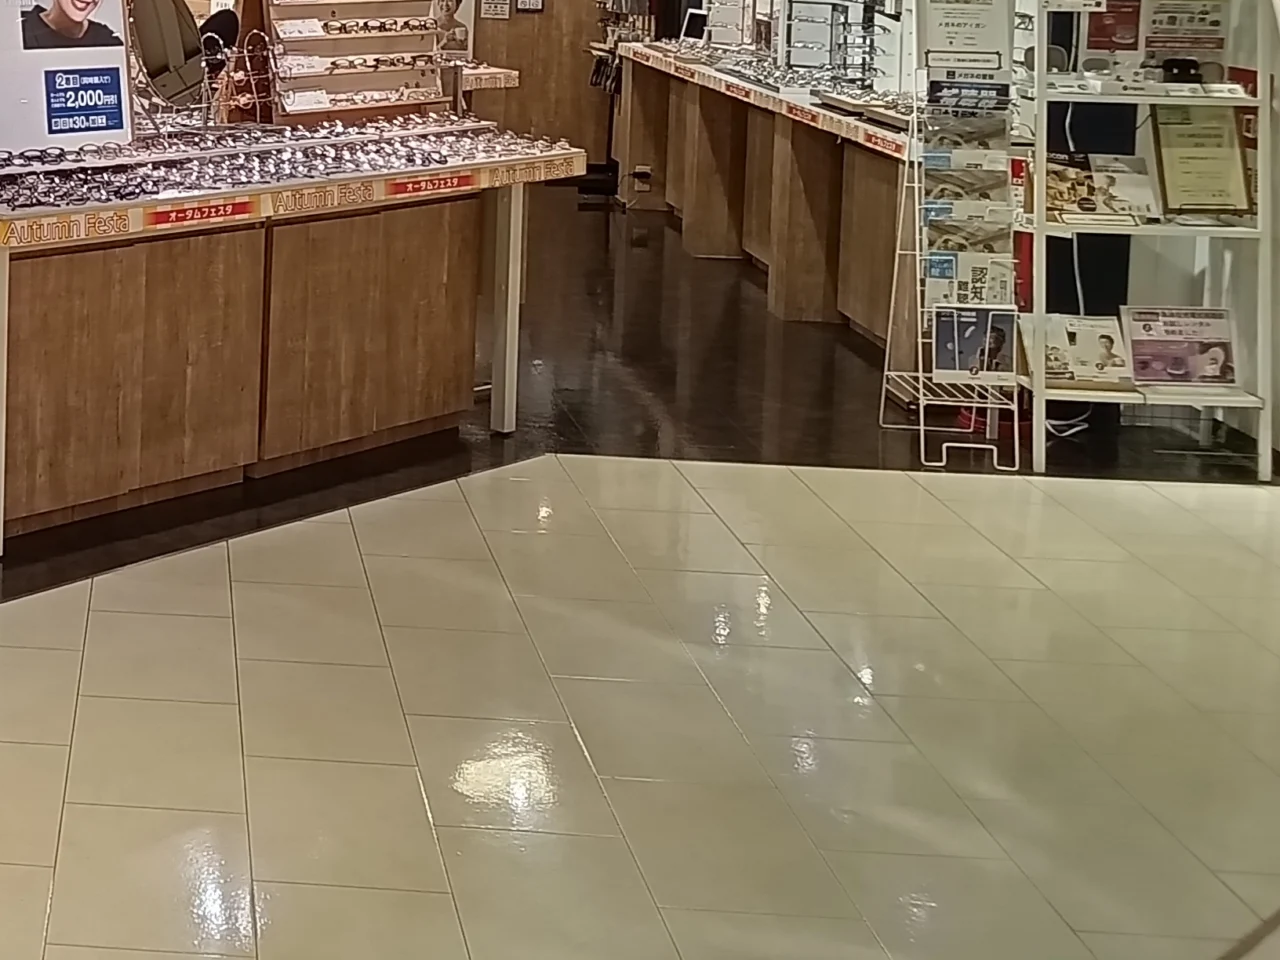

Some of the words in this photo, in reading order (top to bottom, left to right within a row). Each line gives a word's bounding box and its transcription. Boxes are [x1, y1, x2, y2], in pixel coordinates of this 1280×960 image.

[405, 177, 459, 192] オータムフェスタ
[491, 163, 542, 186] Autumn
[544, 158, 576, 179] Festa
[273, 186, 335, 213] Autumn
[337, 182, 375, 203] Festa
[168, 205, 233, 222] オータムフェスタ
[3, 218, 81, 245] Autumn
[85, 211, 130, 237] Festa
